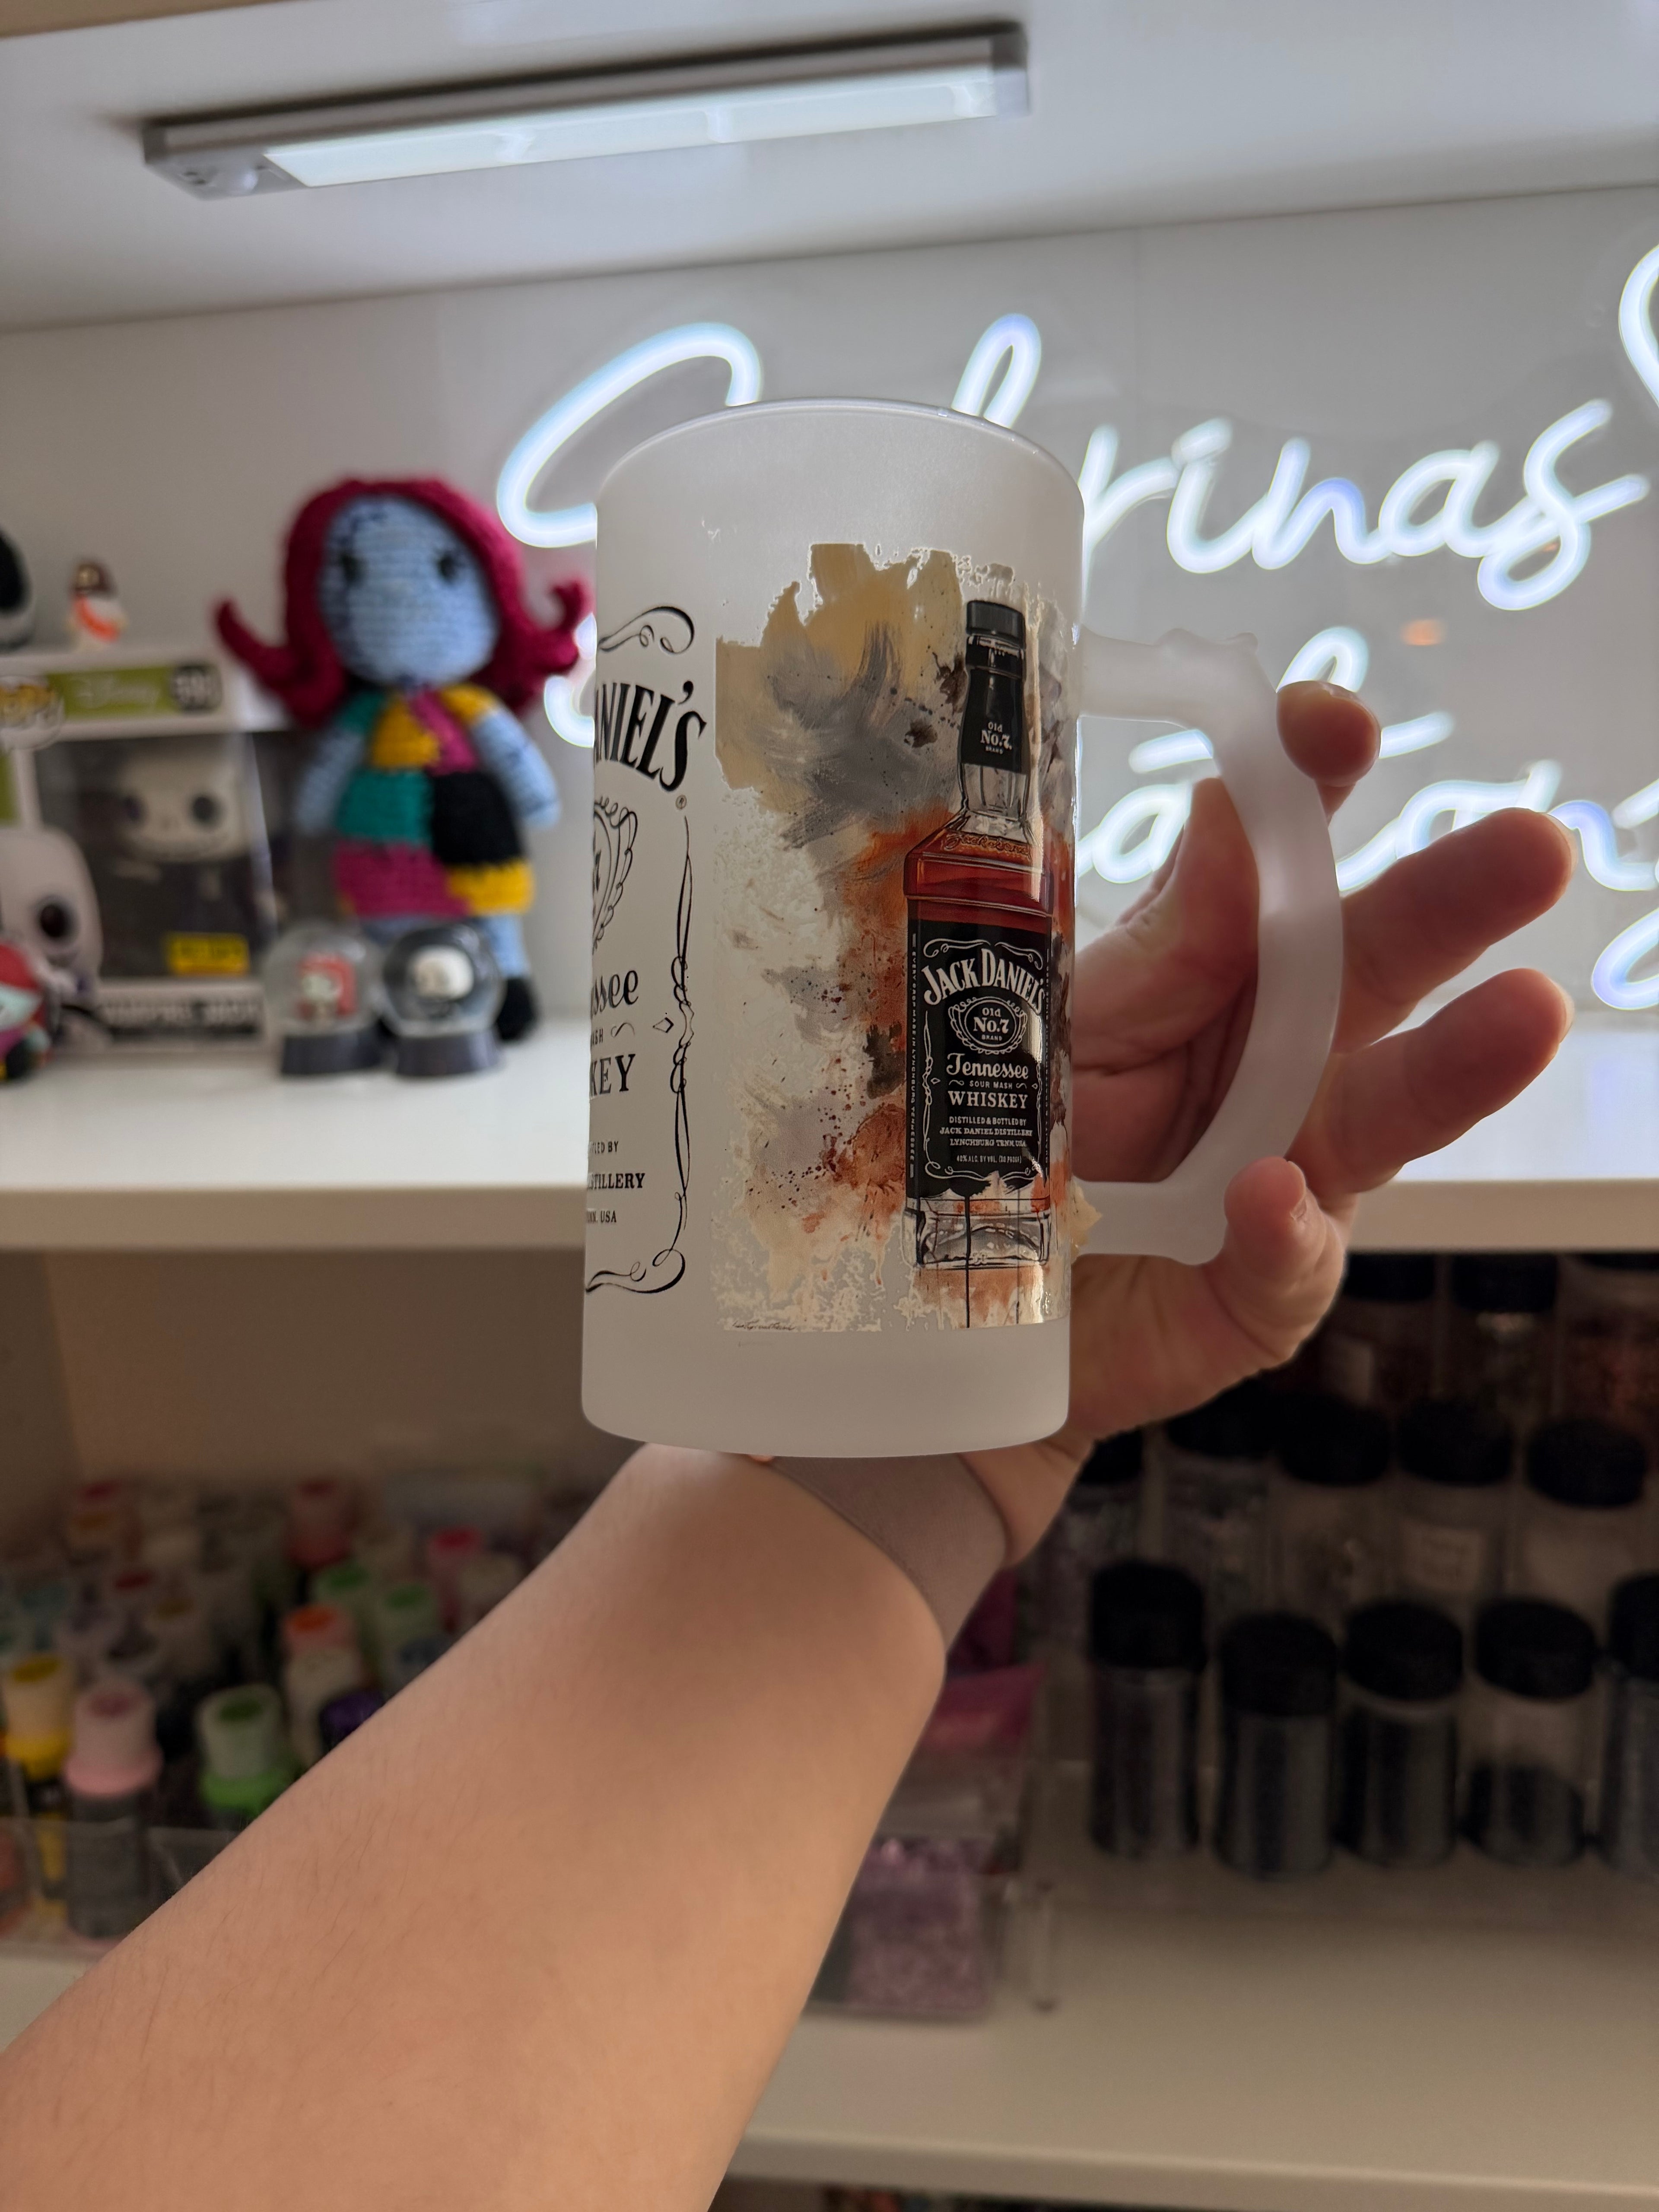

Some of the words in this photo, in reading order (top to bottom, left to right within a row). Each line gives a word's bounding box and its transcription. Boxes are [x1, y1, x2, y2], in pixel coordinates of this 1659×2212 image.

[988, 721, 1002, 733] Old
[595, 680, 707, 792] NIEL'S
[922, 958, 980, 1005] JACK
[981, 948, 1045, 1014] DANIEL'S
[982, 1007, 1001, 1017] Old
[973, 1017, 1009, 1034] No.7
[946, 1052, 1029, 1080] Tennessee
[969, 1080, 990, 1088] SOUR
[993, 1081, 1013, 1090] MASH
[948, 1090, 1028, 1109] WHISKEY
[992, 1117, 1019, 1125] BOTTLED
[994, 1128, 1033, 1137] DISTILLERY
[608, 1141, 619, 1153] BY
[601, 1210, 617, 1223] USA
